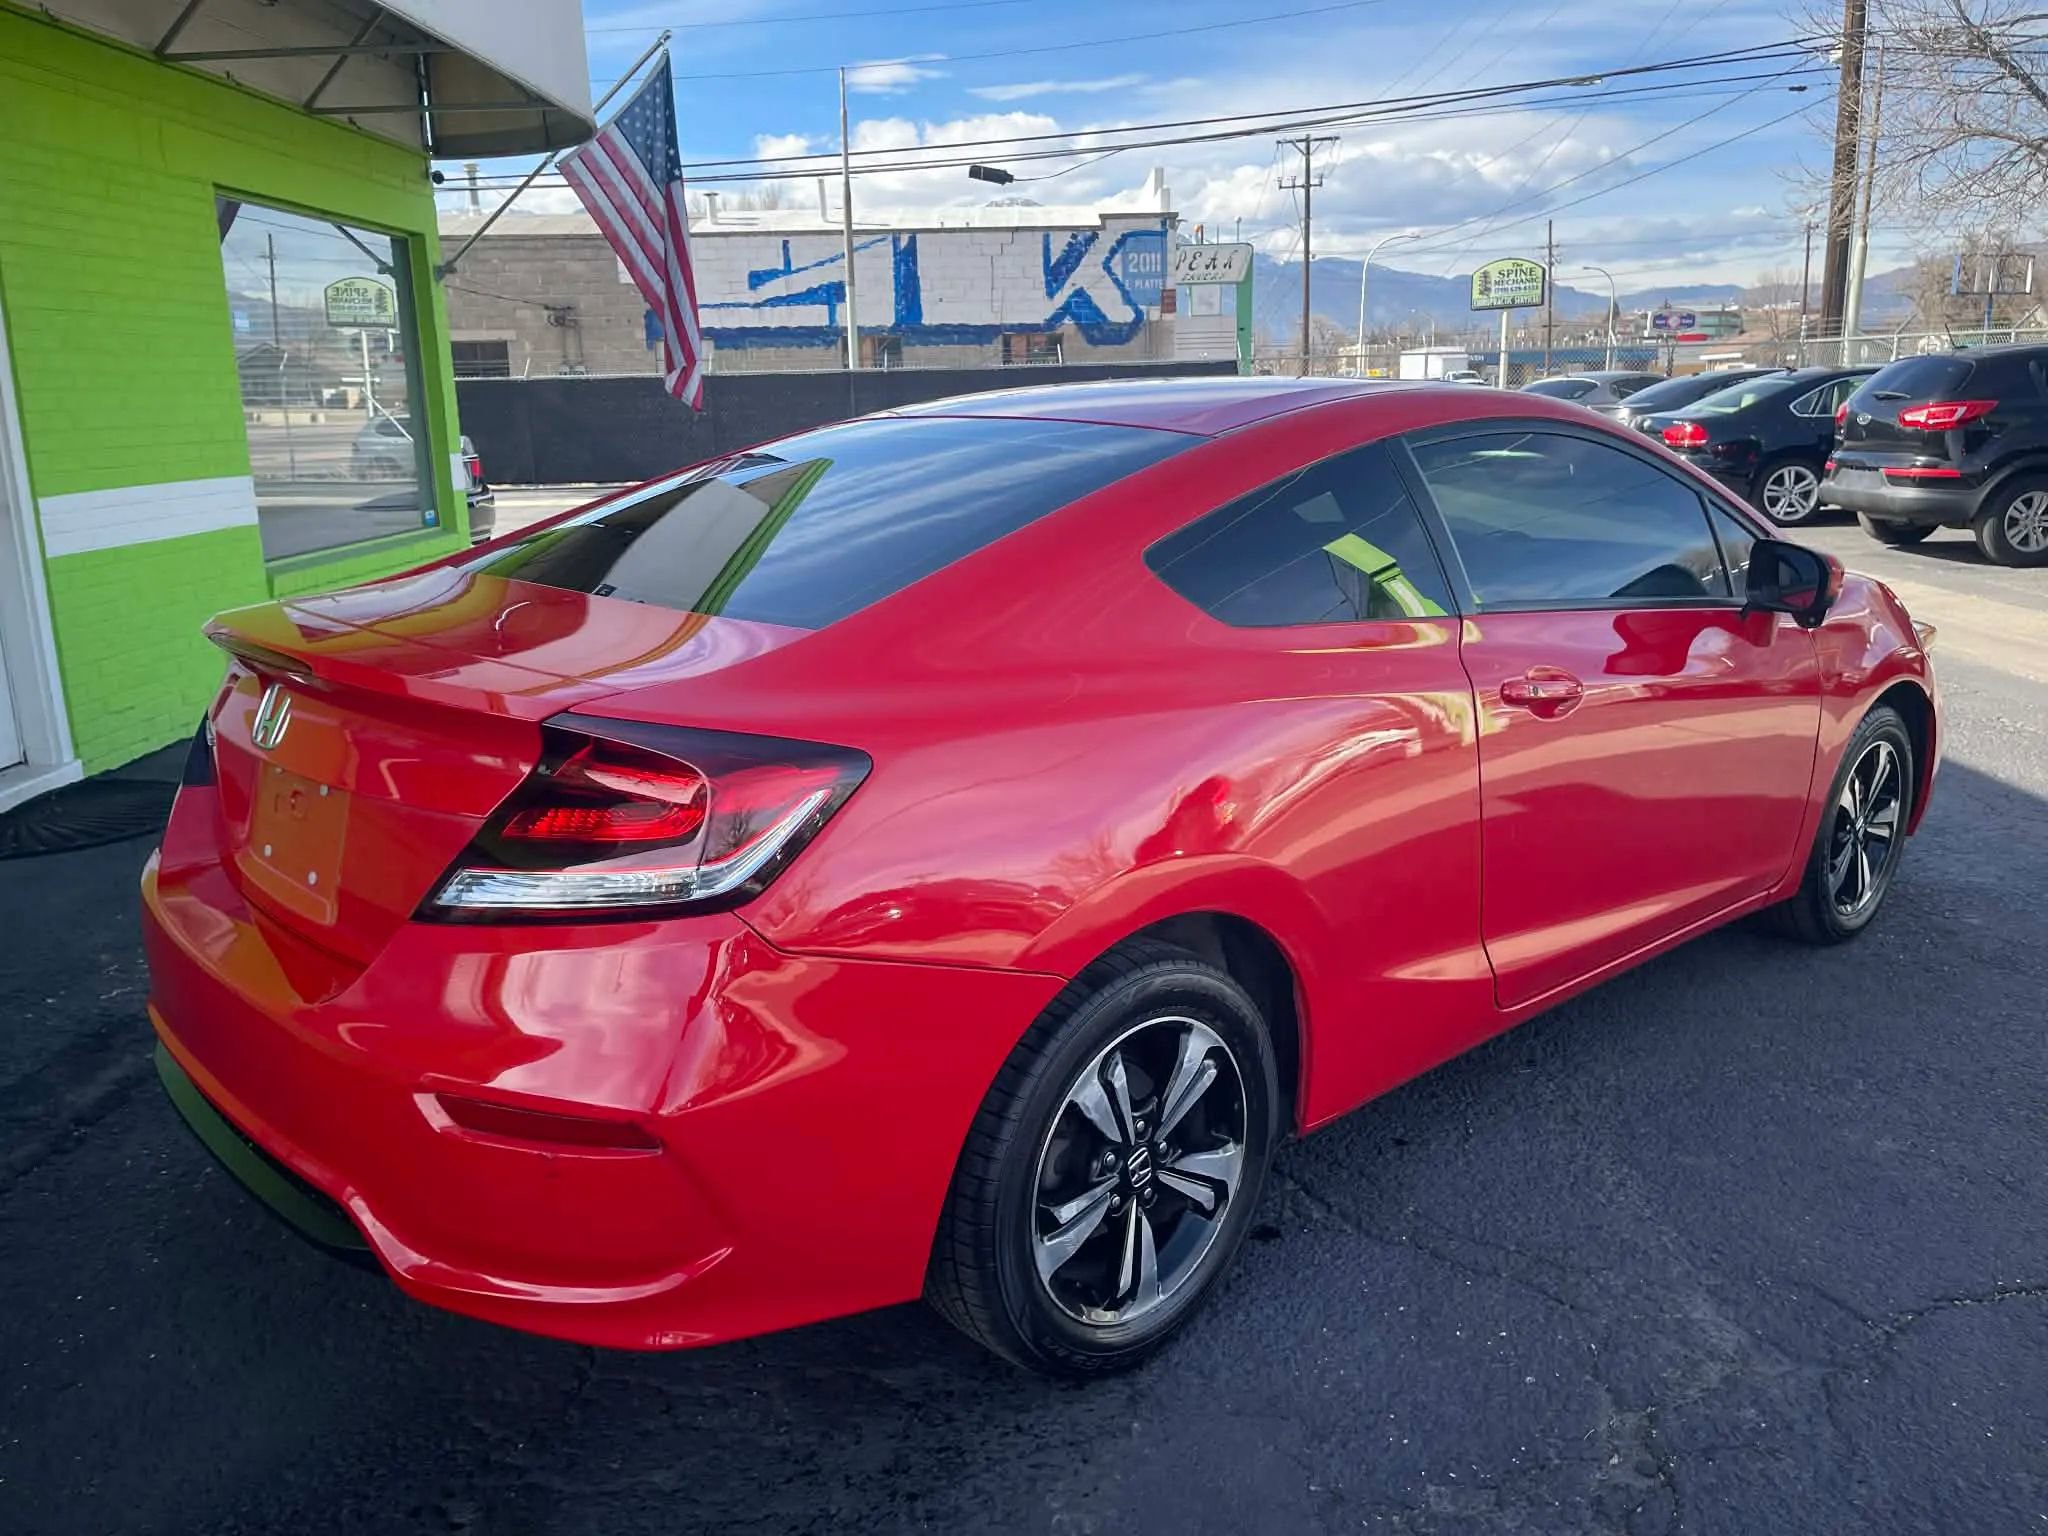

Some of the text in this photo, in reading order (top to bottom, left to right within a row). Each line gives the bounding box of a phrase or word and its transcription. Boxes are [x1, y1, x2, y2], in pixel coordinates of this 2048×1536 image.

[1128, 252, 1161, 272] 2011
[1497, 267, 1537, 279] SPINE
[1135, 279, 1164, 289] PLATTE
